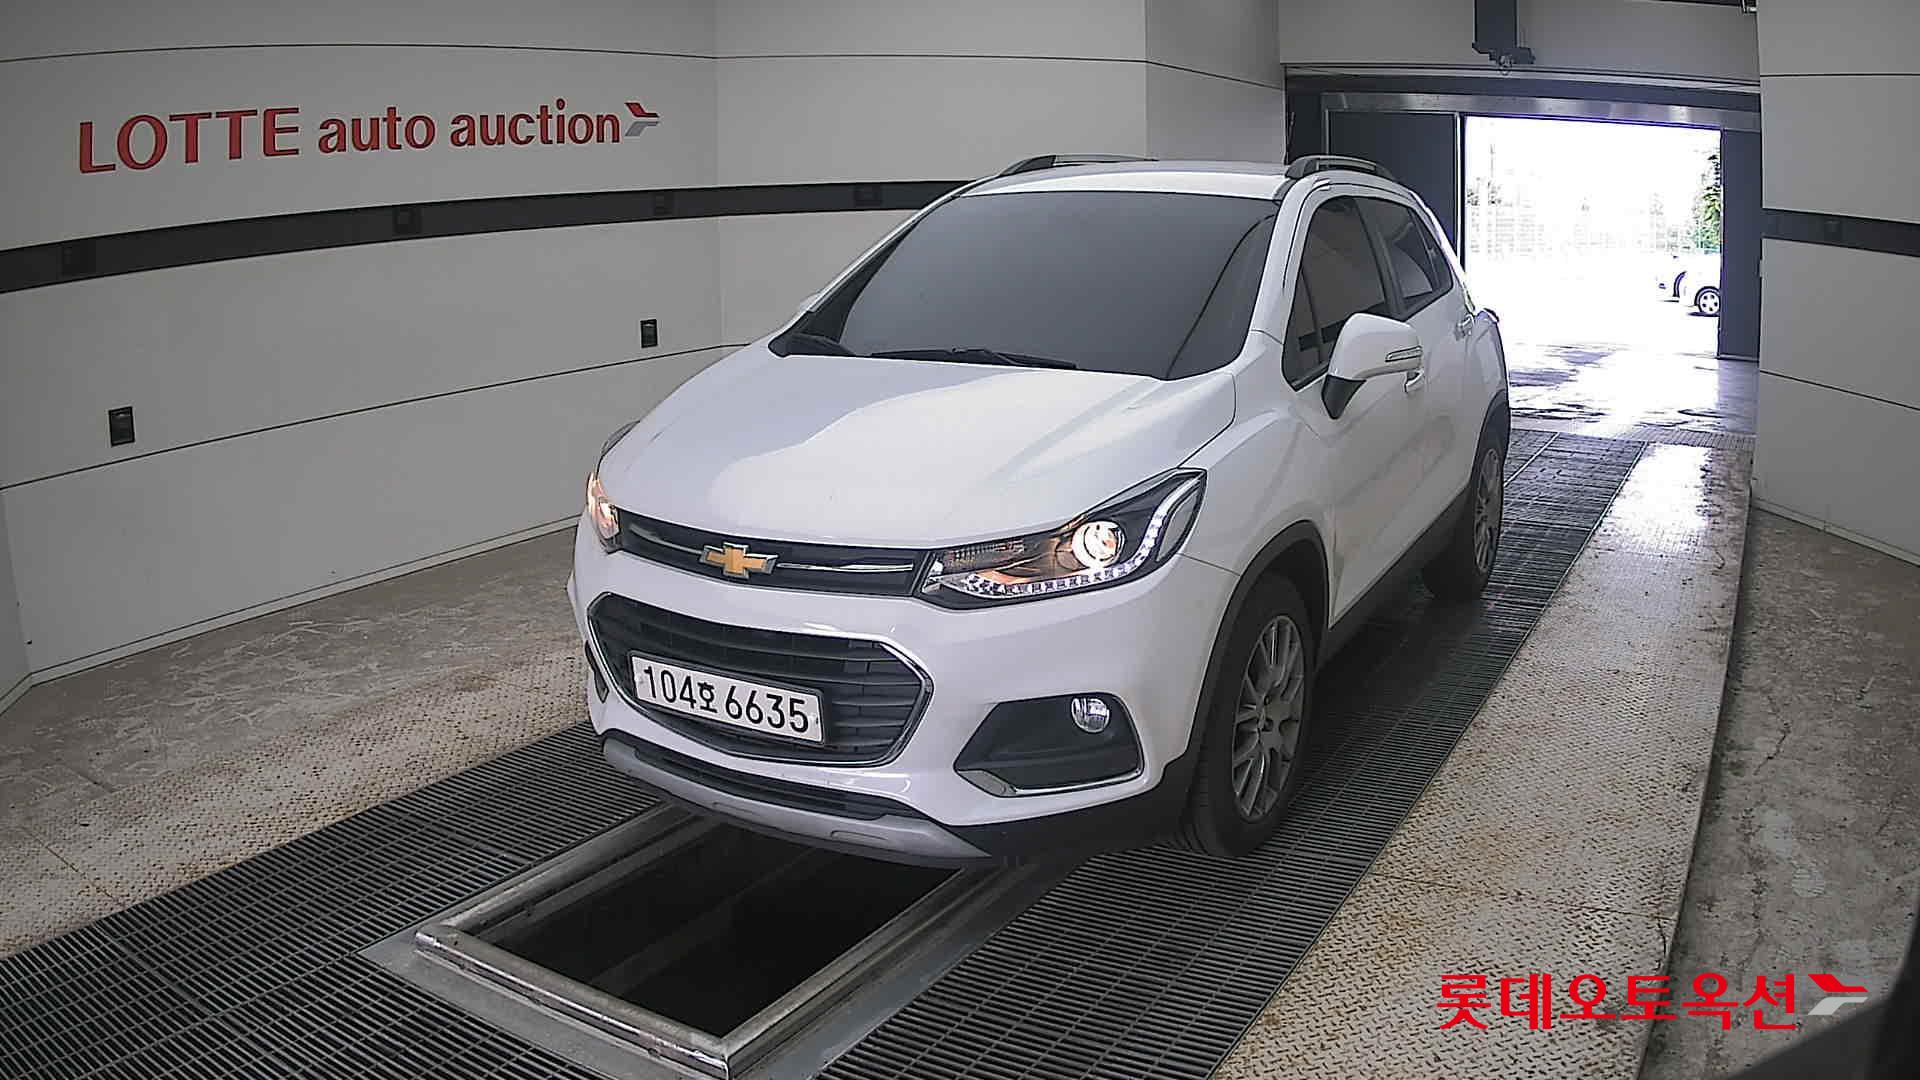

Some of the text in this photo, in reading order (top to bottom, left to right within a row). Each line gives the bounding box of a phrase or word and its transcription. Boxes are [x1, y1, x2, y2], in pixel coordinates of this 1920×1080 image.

[79, 98, 621, 174] LOTTE auto auction
[644, 666, 809, 733] 104호 6635
